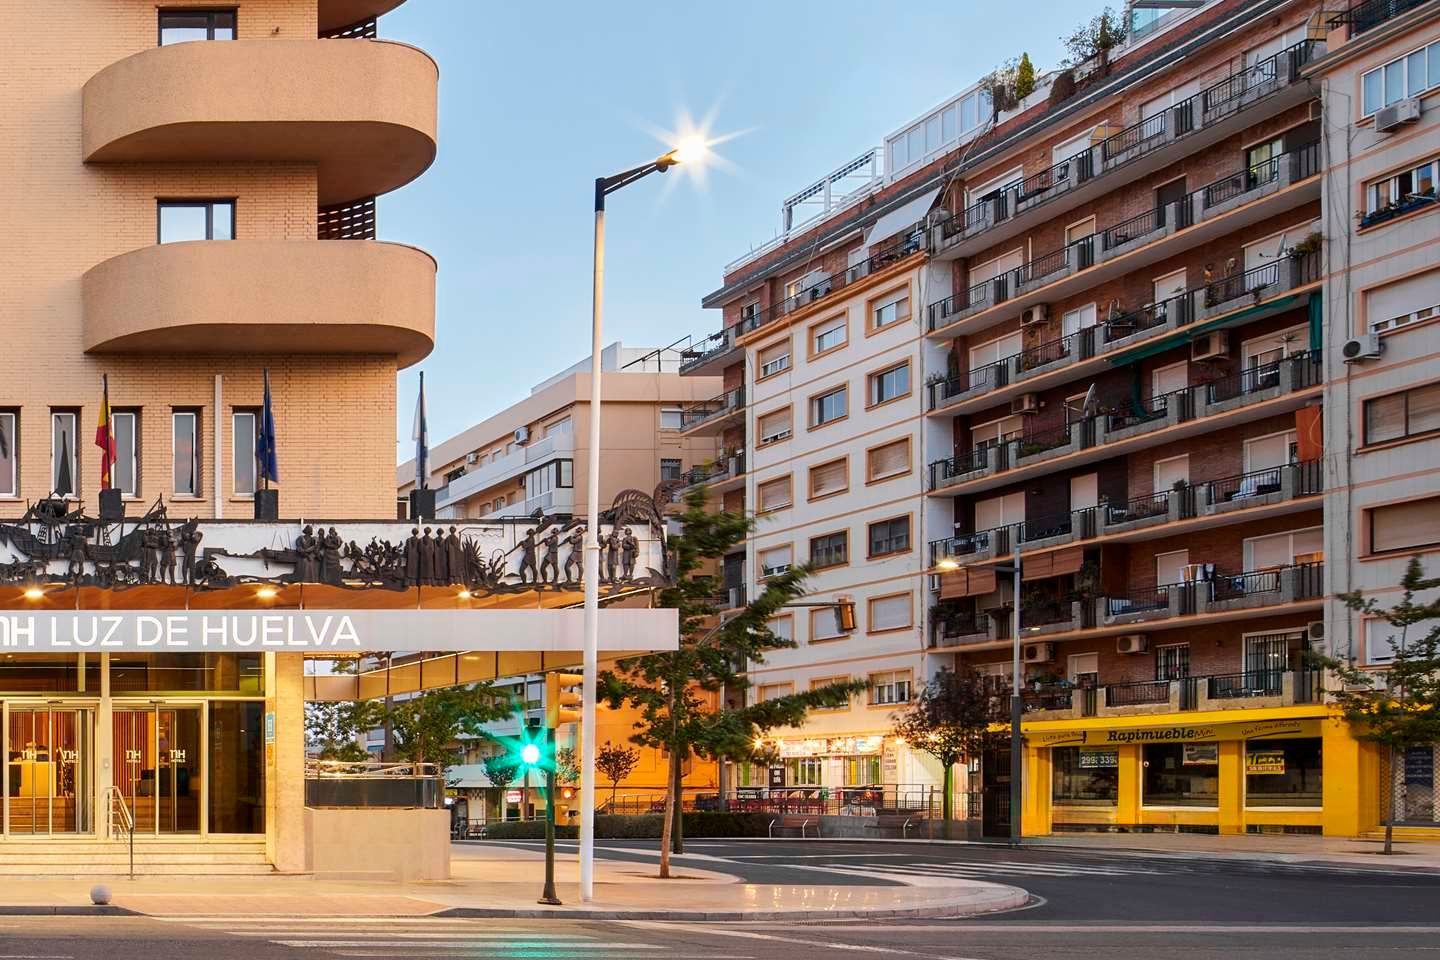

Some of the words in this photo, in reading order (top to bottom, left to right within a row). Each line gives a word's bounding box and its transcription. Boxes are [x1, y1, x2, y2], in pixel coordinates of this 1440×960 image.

[51, 616, 123, 646] LUZ
[137, 616, 188, 646] DE
[202, 616, 360, 646] HUELVA
[1107, 727, 1195, 742] Rapimueble
